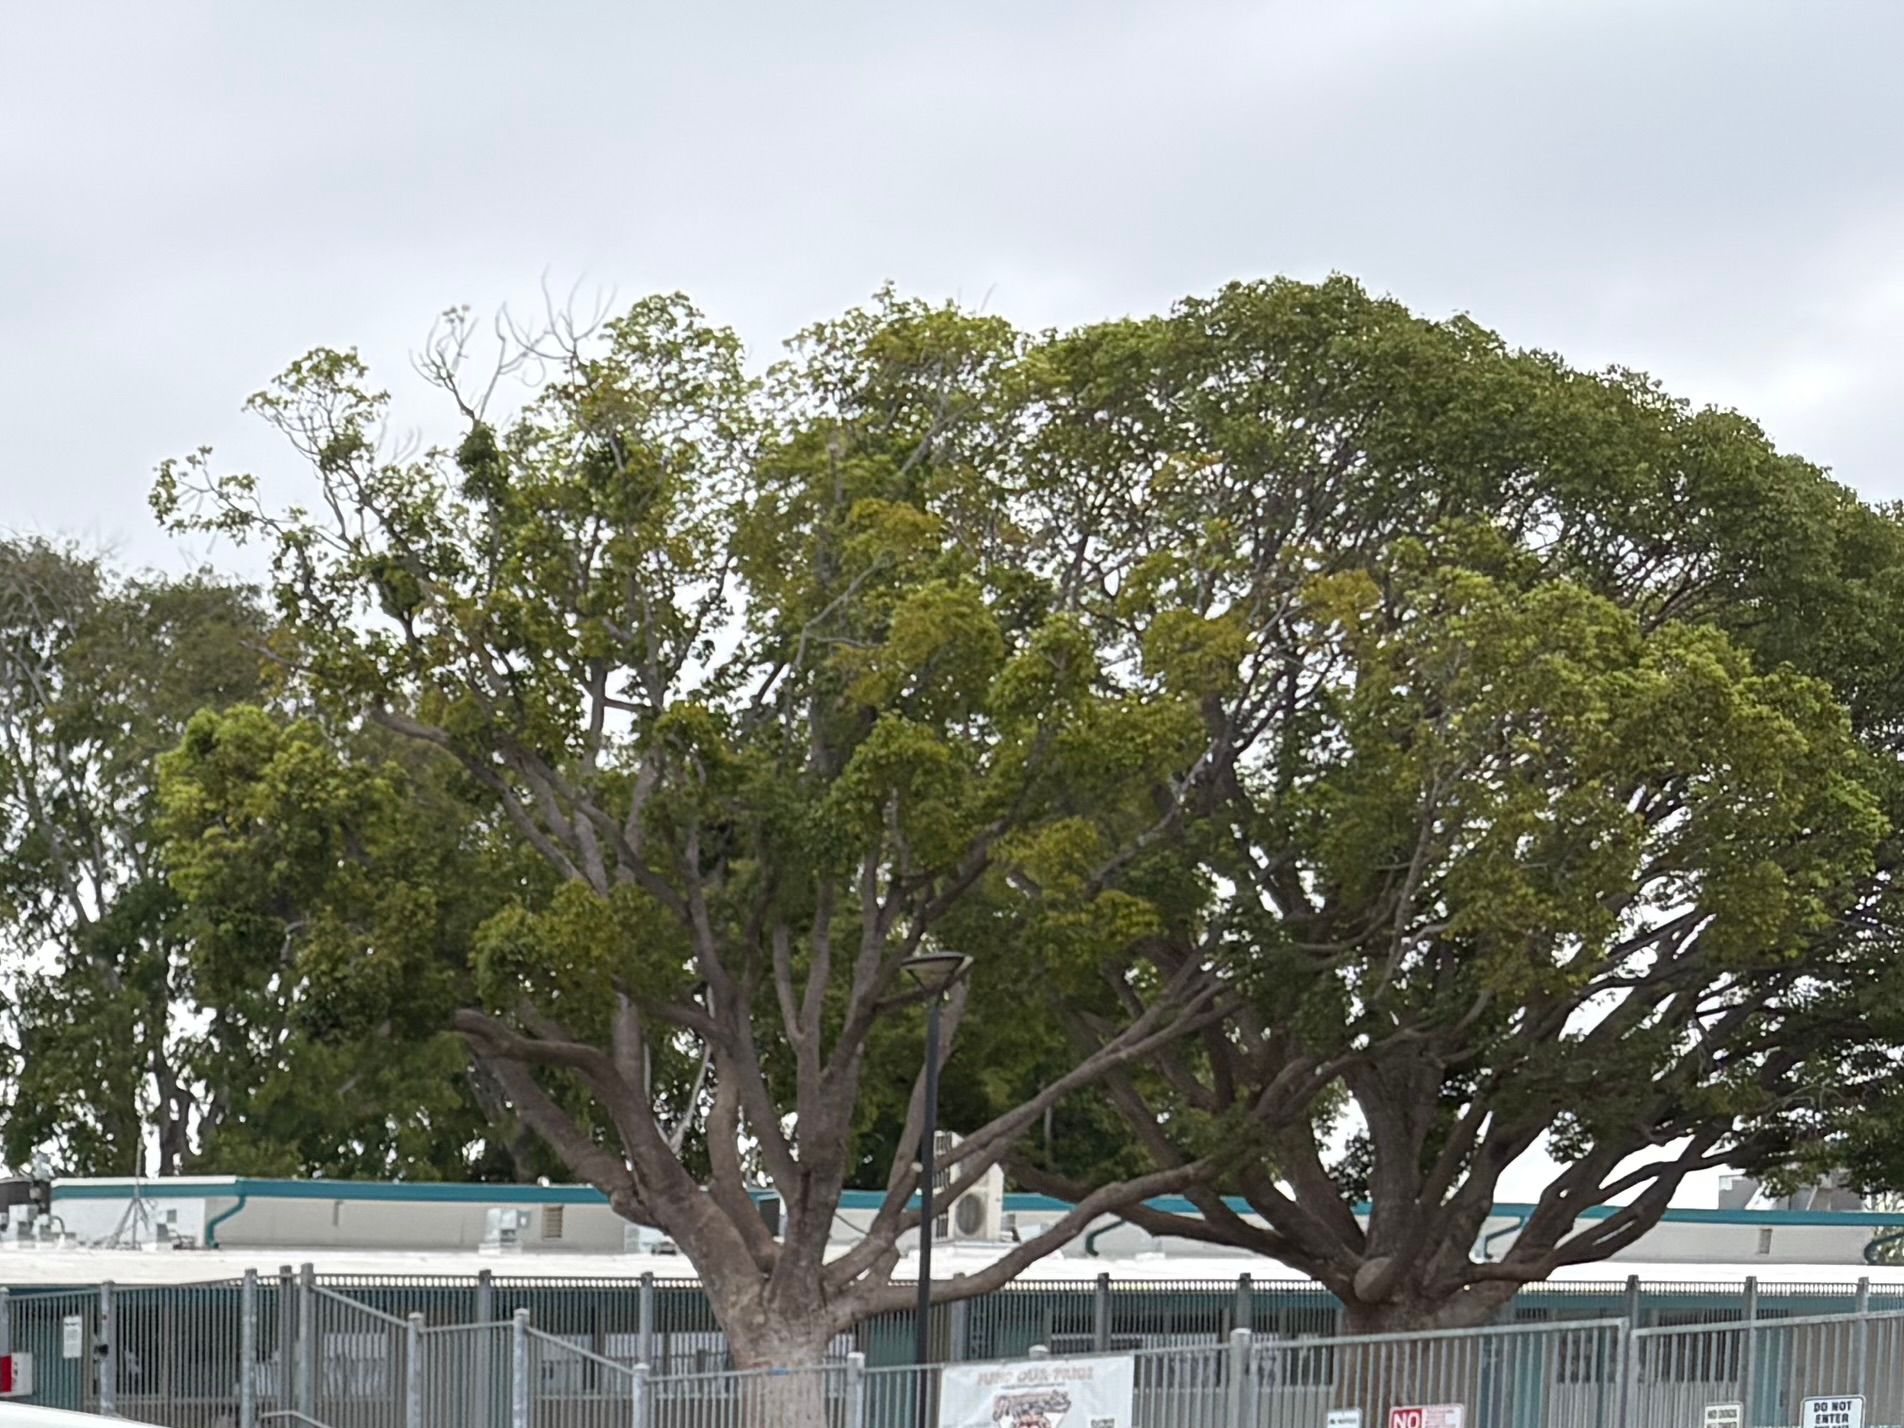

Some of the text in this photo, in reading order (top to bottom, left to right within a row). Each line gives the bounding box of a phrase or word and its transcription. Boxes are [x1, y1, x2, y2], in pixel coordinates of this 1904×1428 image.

[1814, 1401, 1851, 1412] DO NOT
[1815, 1413, 1849, 1424] ENTER
